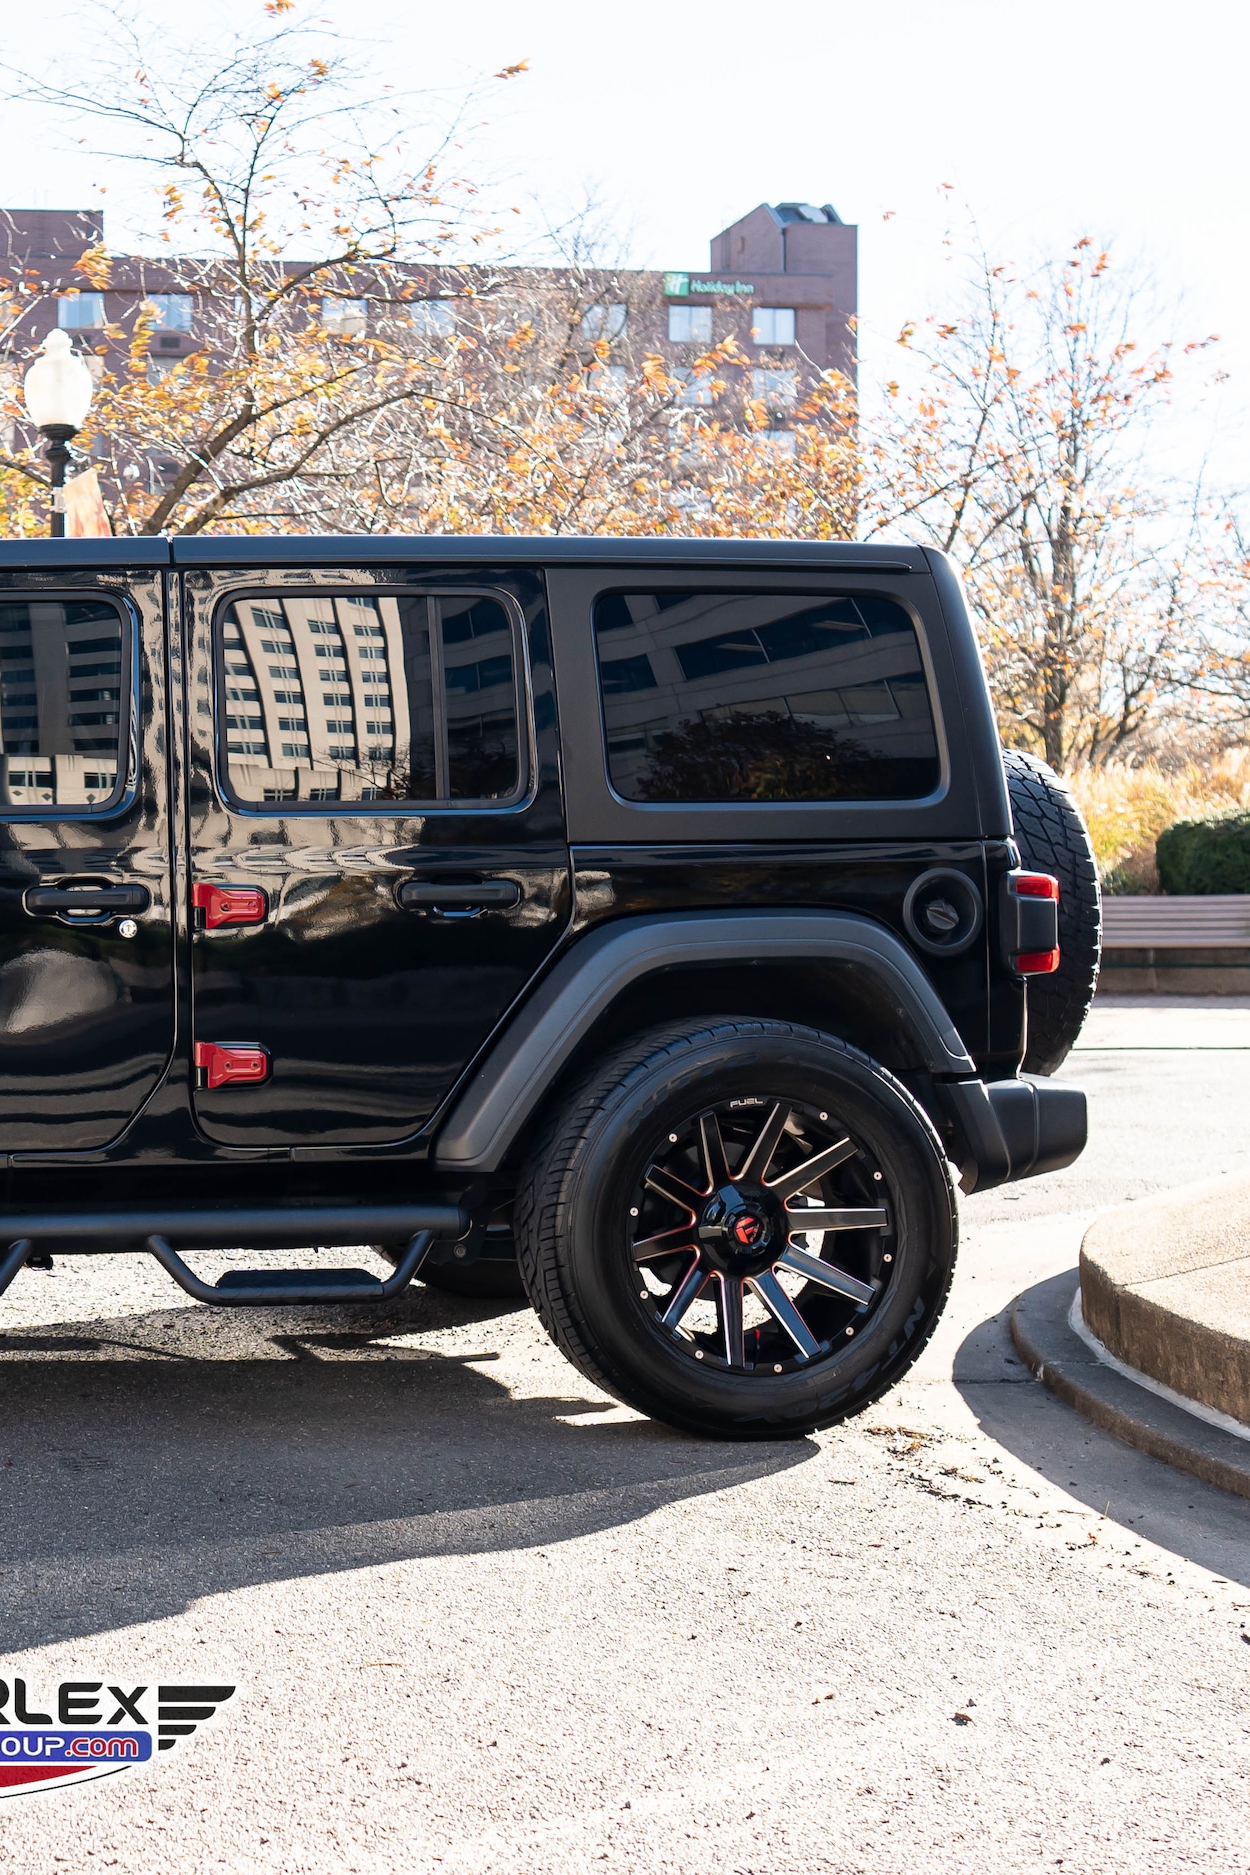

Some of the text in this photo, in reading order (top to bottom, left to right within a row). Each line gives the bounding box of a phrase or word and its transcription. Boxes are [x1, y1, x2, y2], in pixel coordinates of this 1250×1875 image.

[691, 280, 754, 296] Holiday Inn
[730, 1098, 763, 1108] FUEL
